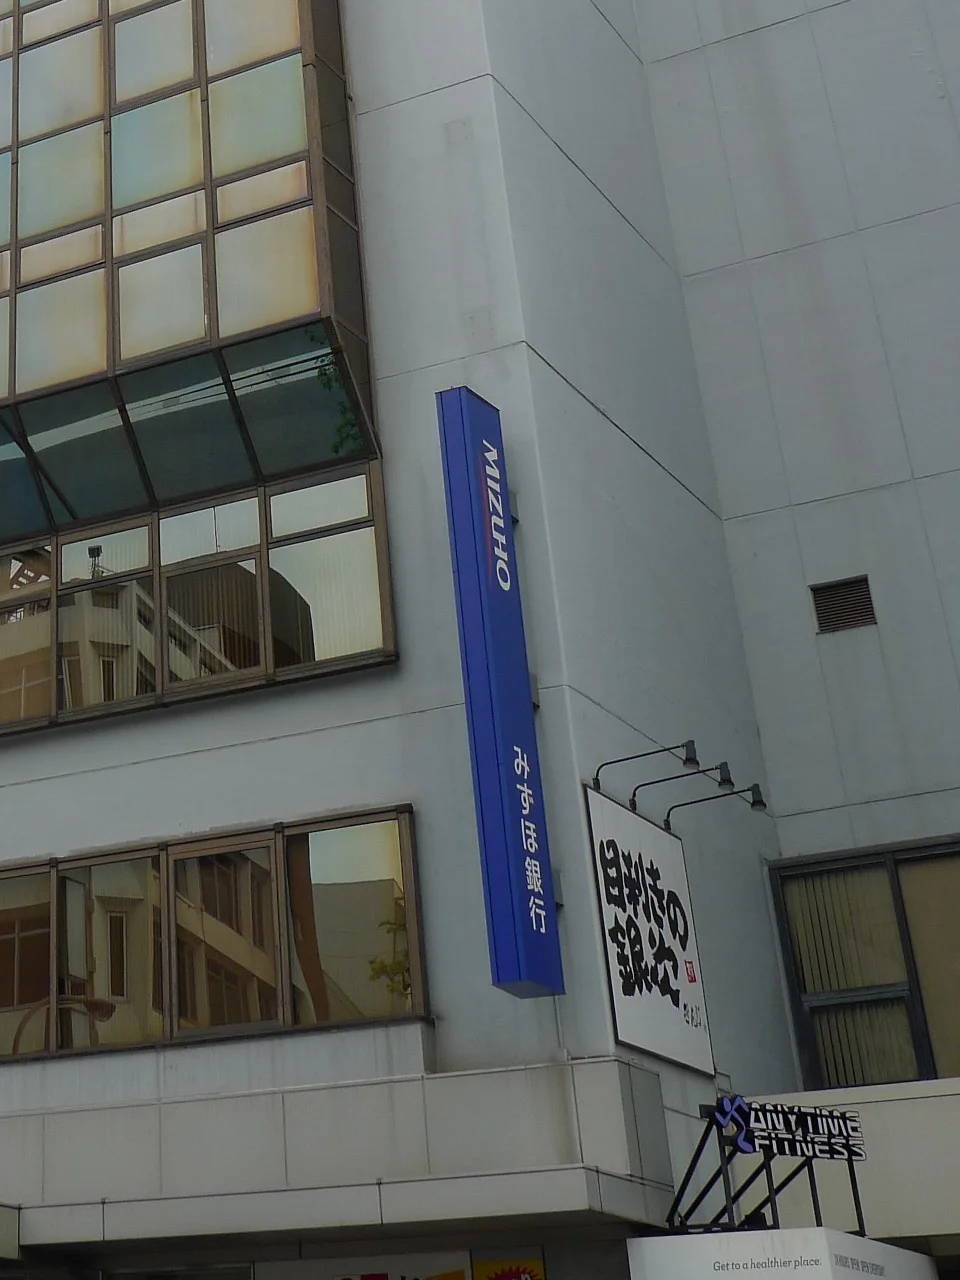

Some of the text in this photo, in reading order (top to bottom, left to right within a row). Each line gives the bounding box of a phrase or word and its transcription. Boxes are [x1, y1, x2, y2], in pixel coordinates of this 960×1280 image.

[482, 438, 511, 592] MIZUHO
[513, 745, 547, 934] みずほ銀行
[599, 838, 689, 952] 目利きの
[608, 911, 680, 1009] 銀次
[749, 1101, 864, 1138] ANYTIME
[753, 1130, 867, 1161] FITNESS
[713, 1255, 822, 1271] Get to a healthier place.
